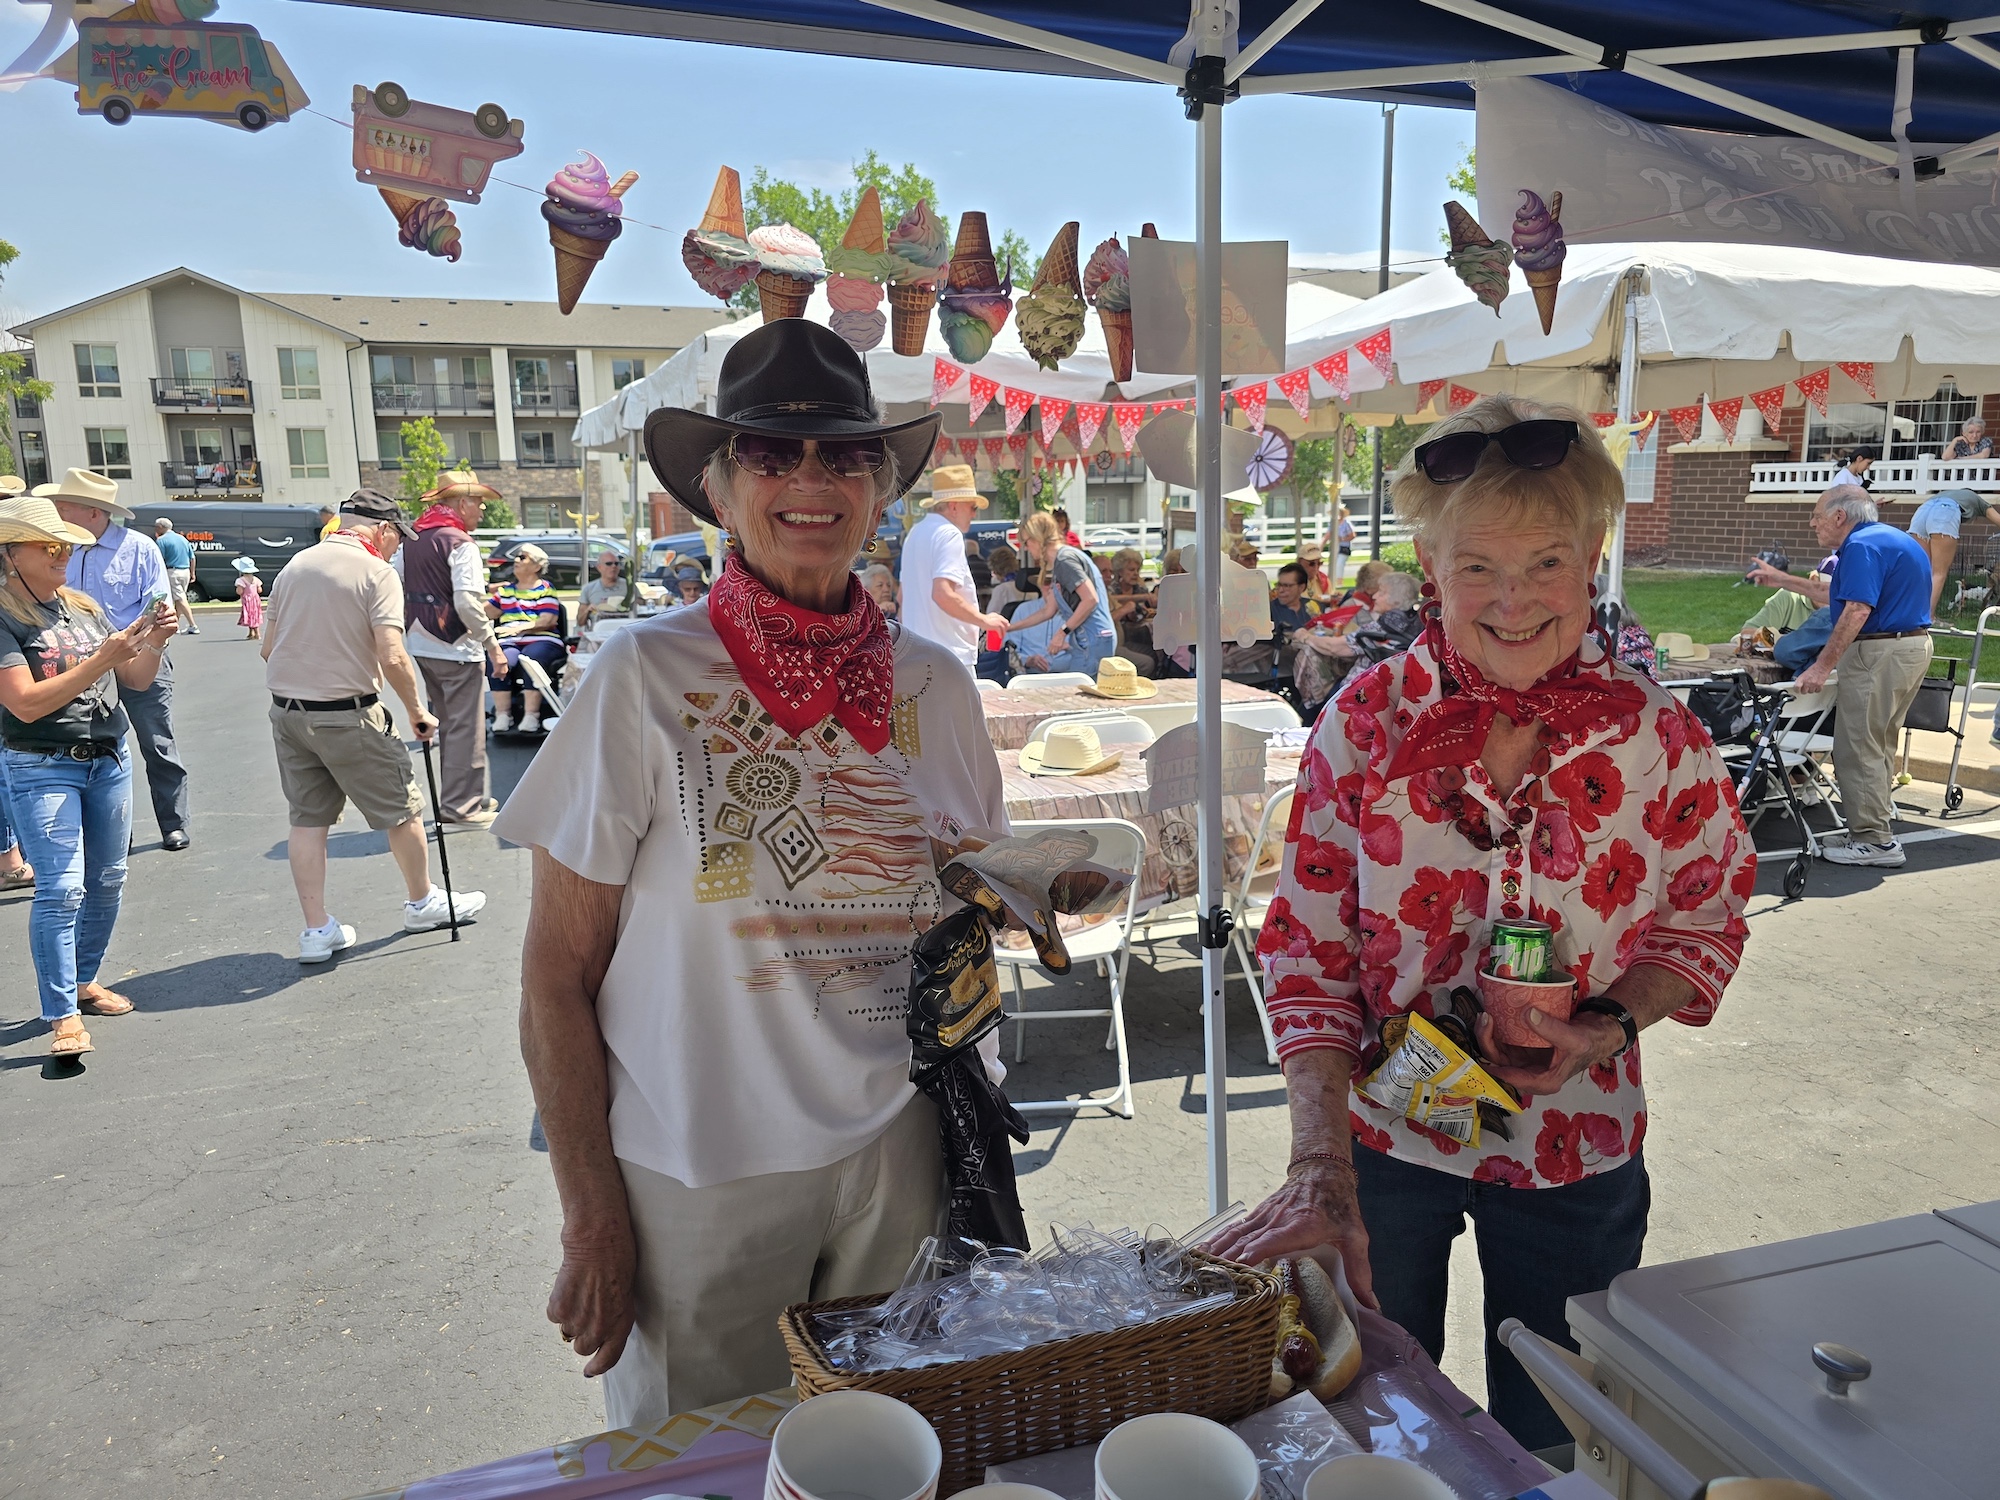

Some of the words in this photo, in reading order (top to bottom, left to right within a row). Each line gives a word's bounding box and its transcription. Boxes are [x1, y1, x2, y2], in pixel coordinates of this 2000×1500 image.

[92, 42, 151, 90] Ice
[159, 47, 254, 91] Cream
[186, 530, 214, 541] deals
[200, 541, 225, 551] turn.
[1409, 1029, 1433, 1053] Nutrition
[1431, 1049, 1447, 1065] Facts
[1418, 1065, 1431, 1077] 160
